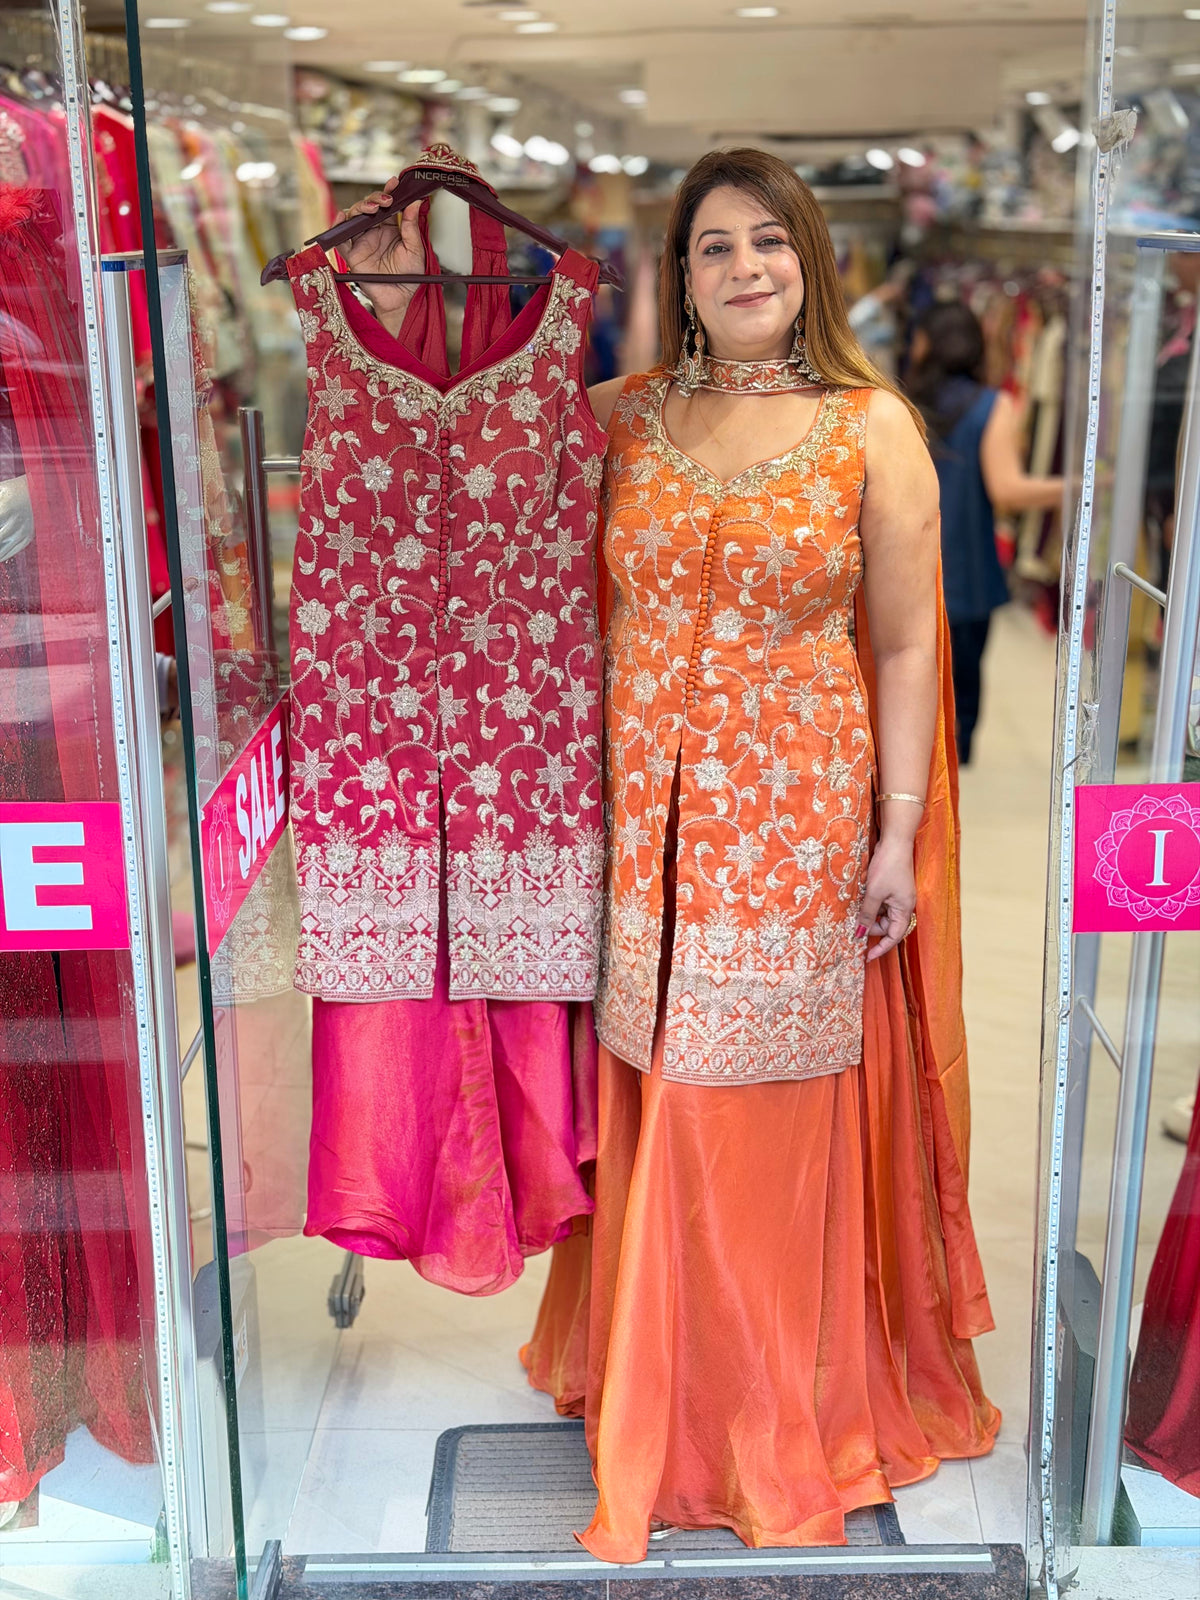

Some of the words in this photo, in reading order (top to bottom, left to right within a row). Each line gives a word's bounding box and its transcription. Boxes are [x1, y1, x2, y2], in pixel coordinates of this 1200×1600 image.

[414, 170, 470, 184] INCREASE
[235, 719, 286, 880] SALE
[1144, 829, 1174, 887] I
